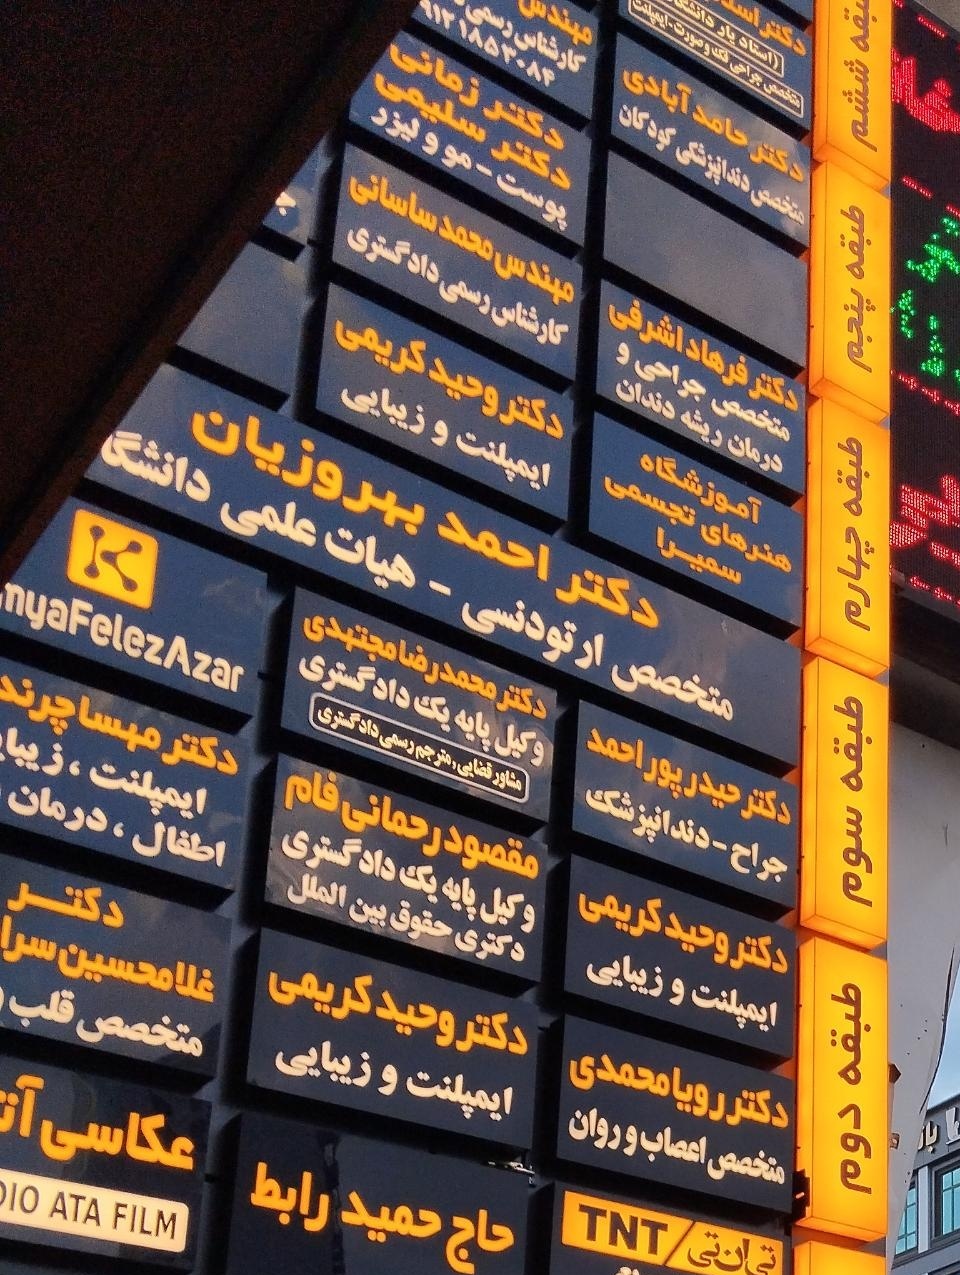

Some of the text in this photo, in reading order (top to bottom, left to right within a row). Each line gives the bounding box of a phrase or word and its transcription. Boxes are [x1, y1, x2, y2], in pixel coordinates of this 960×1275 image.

[465, 4, 586, 72] کارشناس رسمی
[759, 21, 806, 56] دکتر
[842, 0, 877, 152] بقه ششم
[374, 73, 571, 189] دکتر سلیمی
[390, 43, 564, 150] دکتر زمانی
[618, 104, 676, 151] کودکان
[623, 69, 804, 182] دکتر حامد آبادی
[350, 175, 437, 232] ساسانی
[371, 107, 567, 231] پوست مو و لیزر
[751, 188, 805, 224] متخصص
[437, 216, 493, 261] محمد
[439, 280, 568, 345] کارشناس رسمی
[494, 251, 575, 305] مهندس
[840, 205, 876, 373] طبقه پنجم
[335, 319, 564, 439] دکتر وحید کریمی
[608, 300, 798, 411] دکتر فرهاد اشرفی
[616, 342, 790, 441] متخصص جراحی و
[341, 388, 551, 490] ایمپلنت و زیبایی
[615, 379, 783, 473] درمان ریشه دندان
[190, 410, 660, 629] دکتر احمد بهروزیان
[220, 501, 317, 548] علمی
[604, 475, 792, 573] هنرهای تجسمی
[640, 453, 761, 524] آموزشگاه
[324, 527, 417, 590] هیات
[656, 526, 743, 585] سمیرا
[837, 437, 875, 632] طبقه چهارم
[0, 582, 244, 693] nyaFelezAzar
[303, 614, 399, 662] مجتهدی
[461, 600, 604, 670] ارتودنسی
[78, 695, 162, 753] مهسا
[496, 684, 547, 719] دکتر
[611, 662, 735, 722] متخصص
[0, 727, 63, 777] زیبا
[162, 734, 238, 776] دکتر
[413, 695, 544, 767] وکیل پایه یک
[586, 728, 791, 825] دکتر احمد
[833, 696, 873, 908] طبقه سوم
[8, 785, 226, 868] اطفال درمان
[285, 771, 539, 879] مقصود رحمانی فام
[7, 883, 125, 928] دکتر
[287, 872, 525, 962] دکتری حقوق بین الملل
[399, 864, 536, 933] وکیل پایه یک
[579, 892, 788, 974] دکتر وحید کریمی
[0, 914, 215, 1003] غلامحسین سرا
[586, 955, 777, 1032] ایمپلنت و زیبایی
[8, 989, 203, 1057] متخصص قلب
[268, 970, 528, 1055] دکتر وحید کریمی
[275, 1040, 513, 1121] ایمپلنت و زیبایی
[569, 1054, 789, 1128] دکتر رویا محمدی
[830, 982, 872, 1195] طبقه دوم
[40, 1112, 195, 1170] عکاسی
[568, 1107, 785, 1185] متخصص اعصاب و روان
[50, 1191, 177, 1240] ATA FILM
[250, 1161, 515, 1275] حاج حمید رابط
[578, 1203, 669, 1256] TNT
